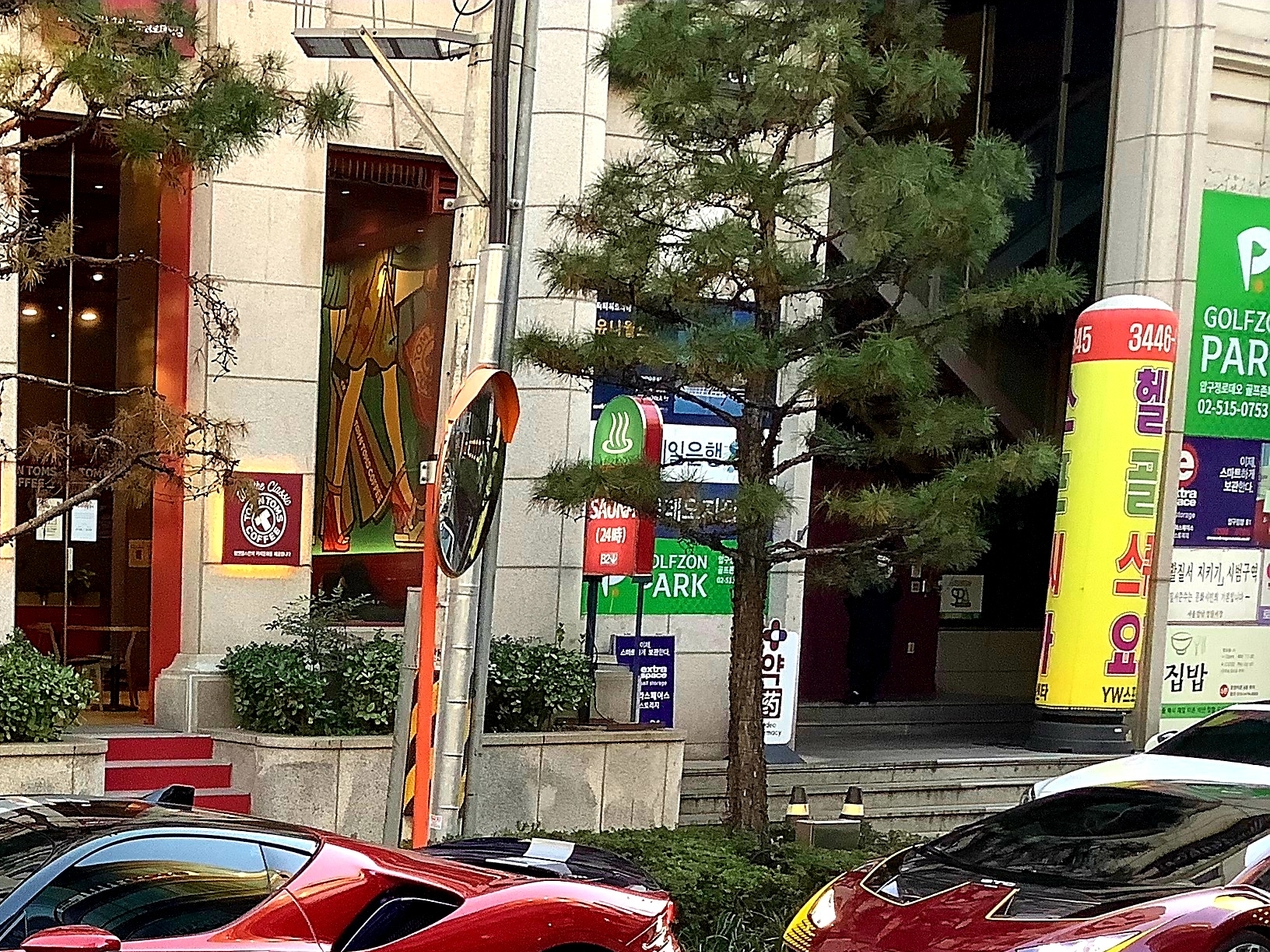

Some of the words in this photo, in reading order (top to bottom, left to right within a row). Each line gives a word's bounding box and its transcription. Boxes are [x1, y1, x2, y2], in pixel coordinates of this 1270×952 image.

[1200, 335, 1269, 378] PAR
[1200, 380, 1243, 395] 압구정로데오
[1245, 383, 1270, 398] 골프존
[1197, 399, 1269, 418] 02-515-0753
[18, 478, 44, 488] FFEE
[1219, 468, 1256, 480] 스마트하게
[1177, 498, 1197, 507] ace
[245, 525, 281, 544] COFFEE
[640, 665, 667, 673] extra
[1164, 662, 1209, 693] 집밥
